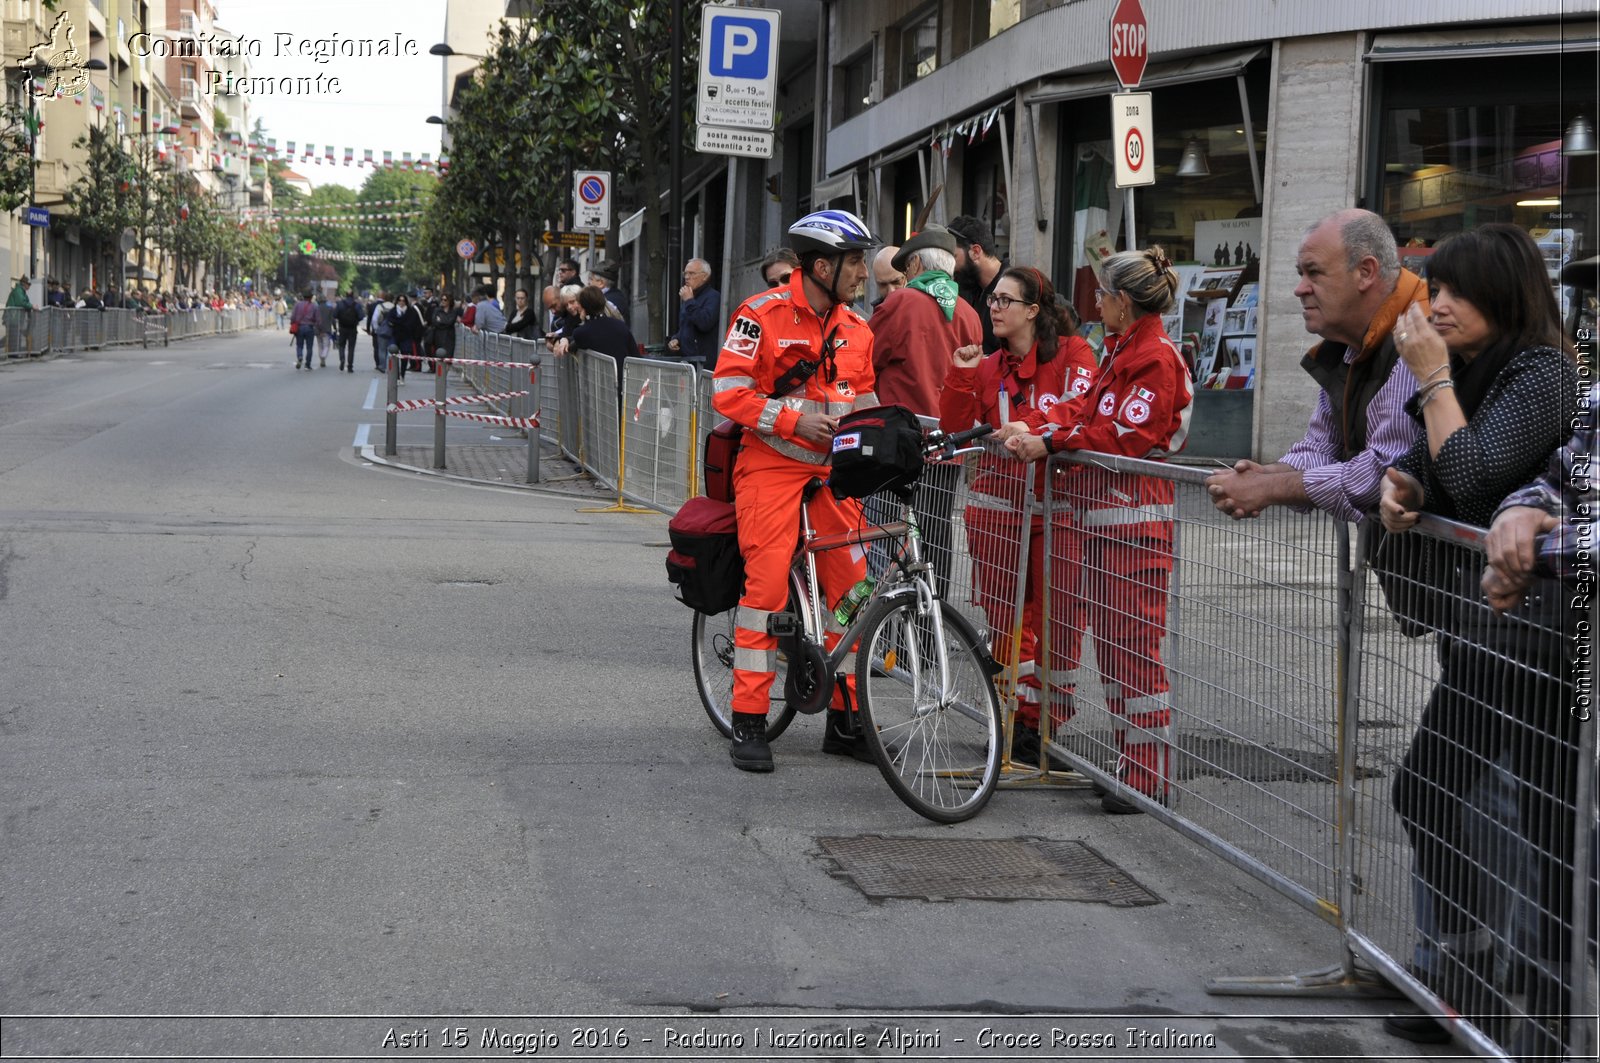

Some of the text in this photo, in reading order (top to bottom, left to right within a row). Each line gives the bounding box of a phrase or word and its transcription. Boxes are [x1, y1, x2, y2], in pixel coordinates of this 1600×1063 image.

[1113, 23, 1146, 58] STOP
[722, 24, 758, 70] P
[725, 99, 772, 109] eccetto festivi
[1126, 106, 1140, 116] zona
[707, 131, 765, 144] sosta massima
[702, 140, 743, 151] consentita
[746, 144, 752, 152] 2
[1129, 140, 1140, 159] 30
[30, 211, 48, 223] PARK
[1232, 220, 1250, 228] ALPINI
[735, 317, 761, 339] 118
[837, 381, 848, 390] 118
[841, 437, 856, 446] 118
